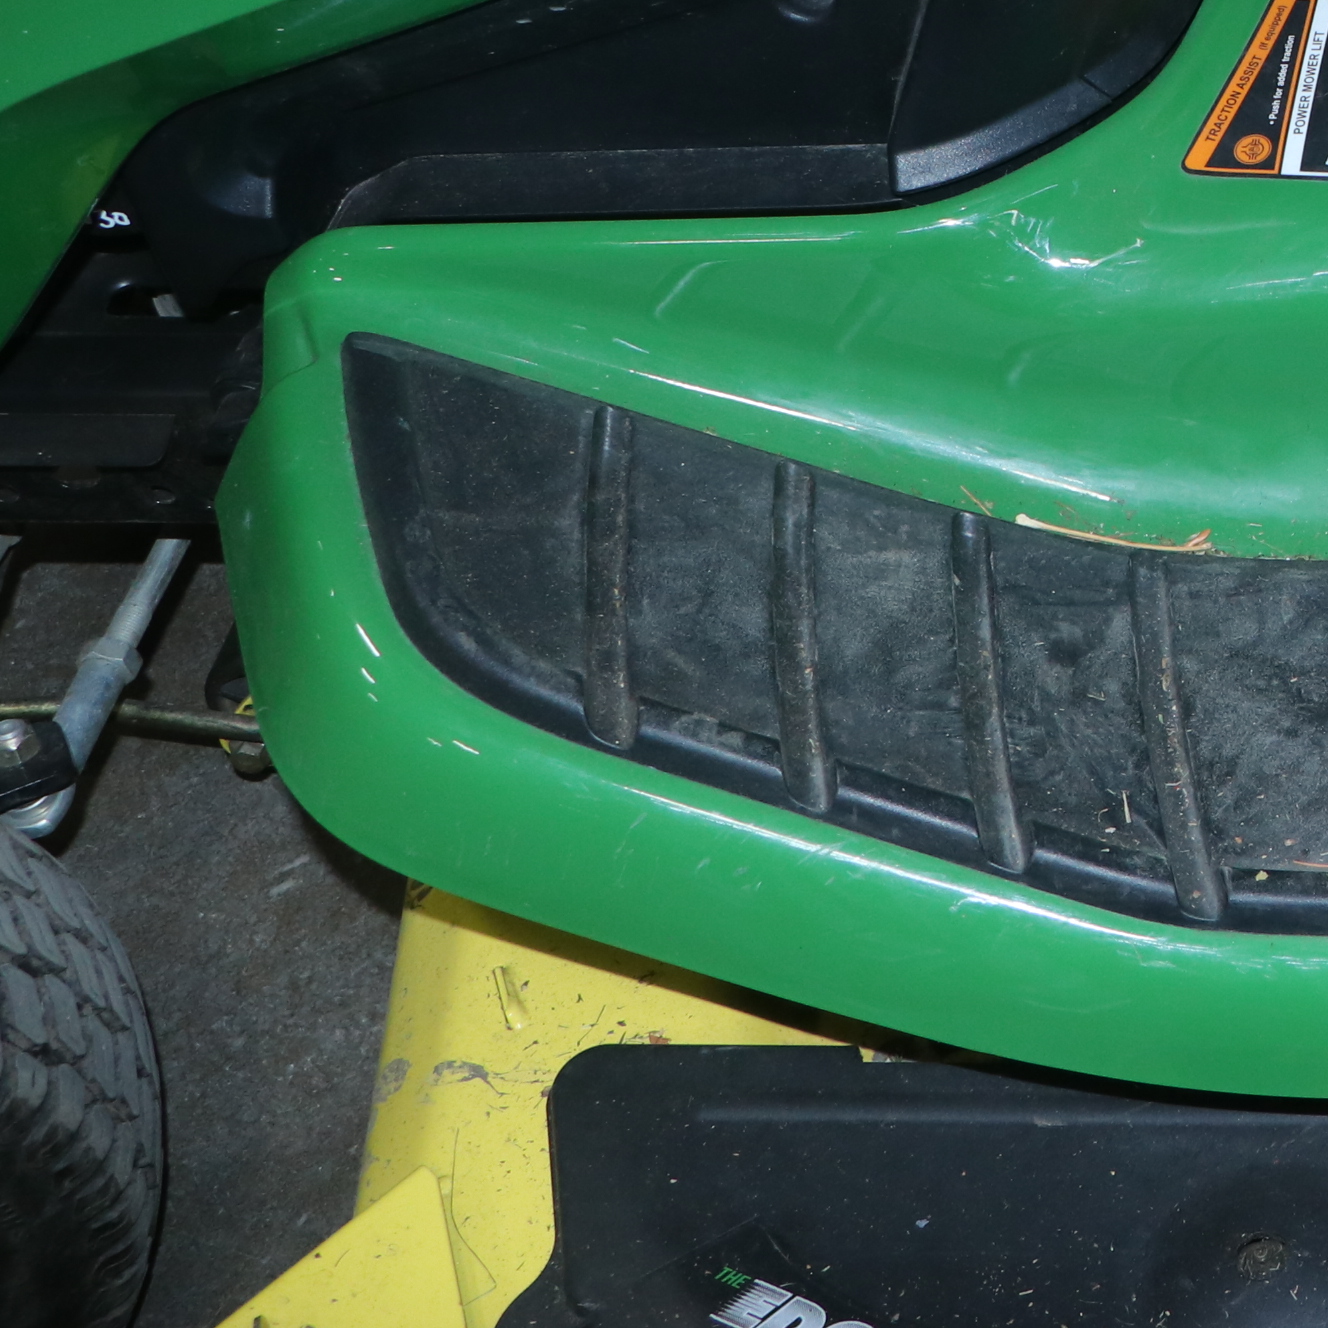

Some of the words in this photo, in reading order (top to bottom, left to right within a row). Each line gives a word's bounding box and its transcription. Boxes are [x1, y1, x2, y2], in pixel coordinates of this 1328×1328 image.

[1281, 35, 1295, 62] traction
[1205, 91, 1241, 142] TRACTION
[1236, 55, 1262, 90] ASSIST
[1263, 6, 1287, 41] equipped)
[1276, 64, 1288, 87] added
[1293, 96, 1311, 134] POWER
[1302, 54, 1320, 92] MOWER
[1311, 31, 1325, 50] LIFT
[1273, 88, 1283, 99] for
[1269, 100, 1281, 119] Push
[714, 1266, 752, 1290] THE
[709, 1278, 882, 1328] ED
